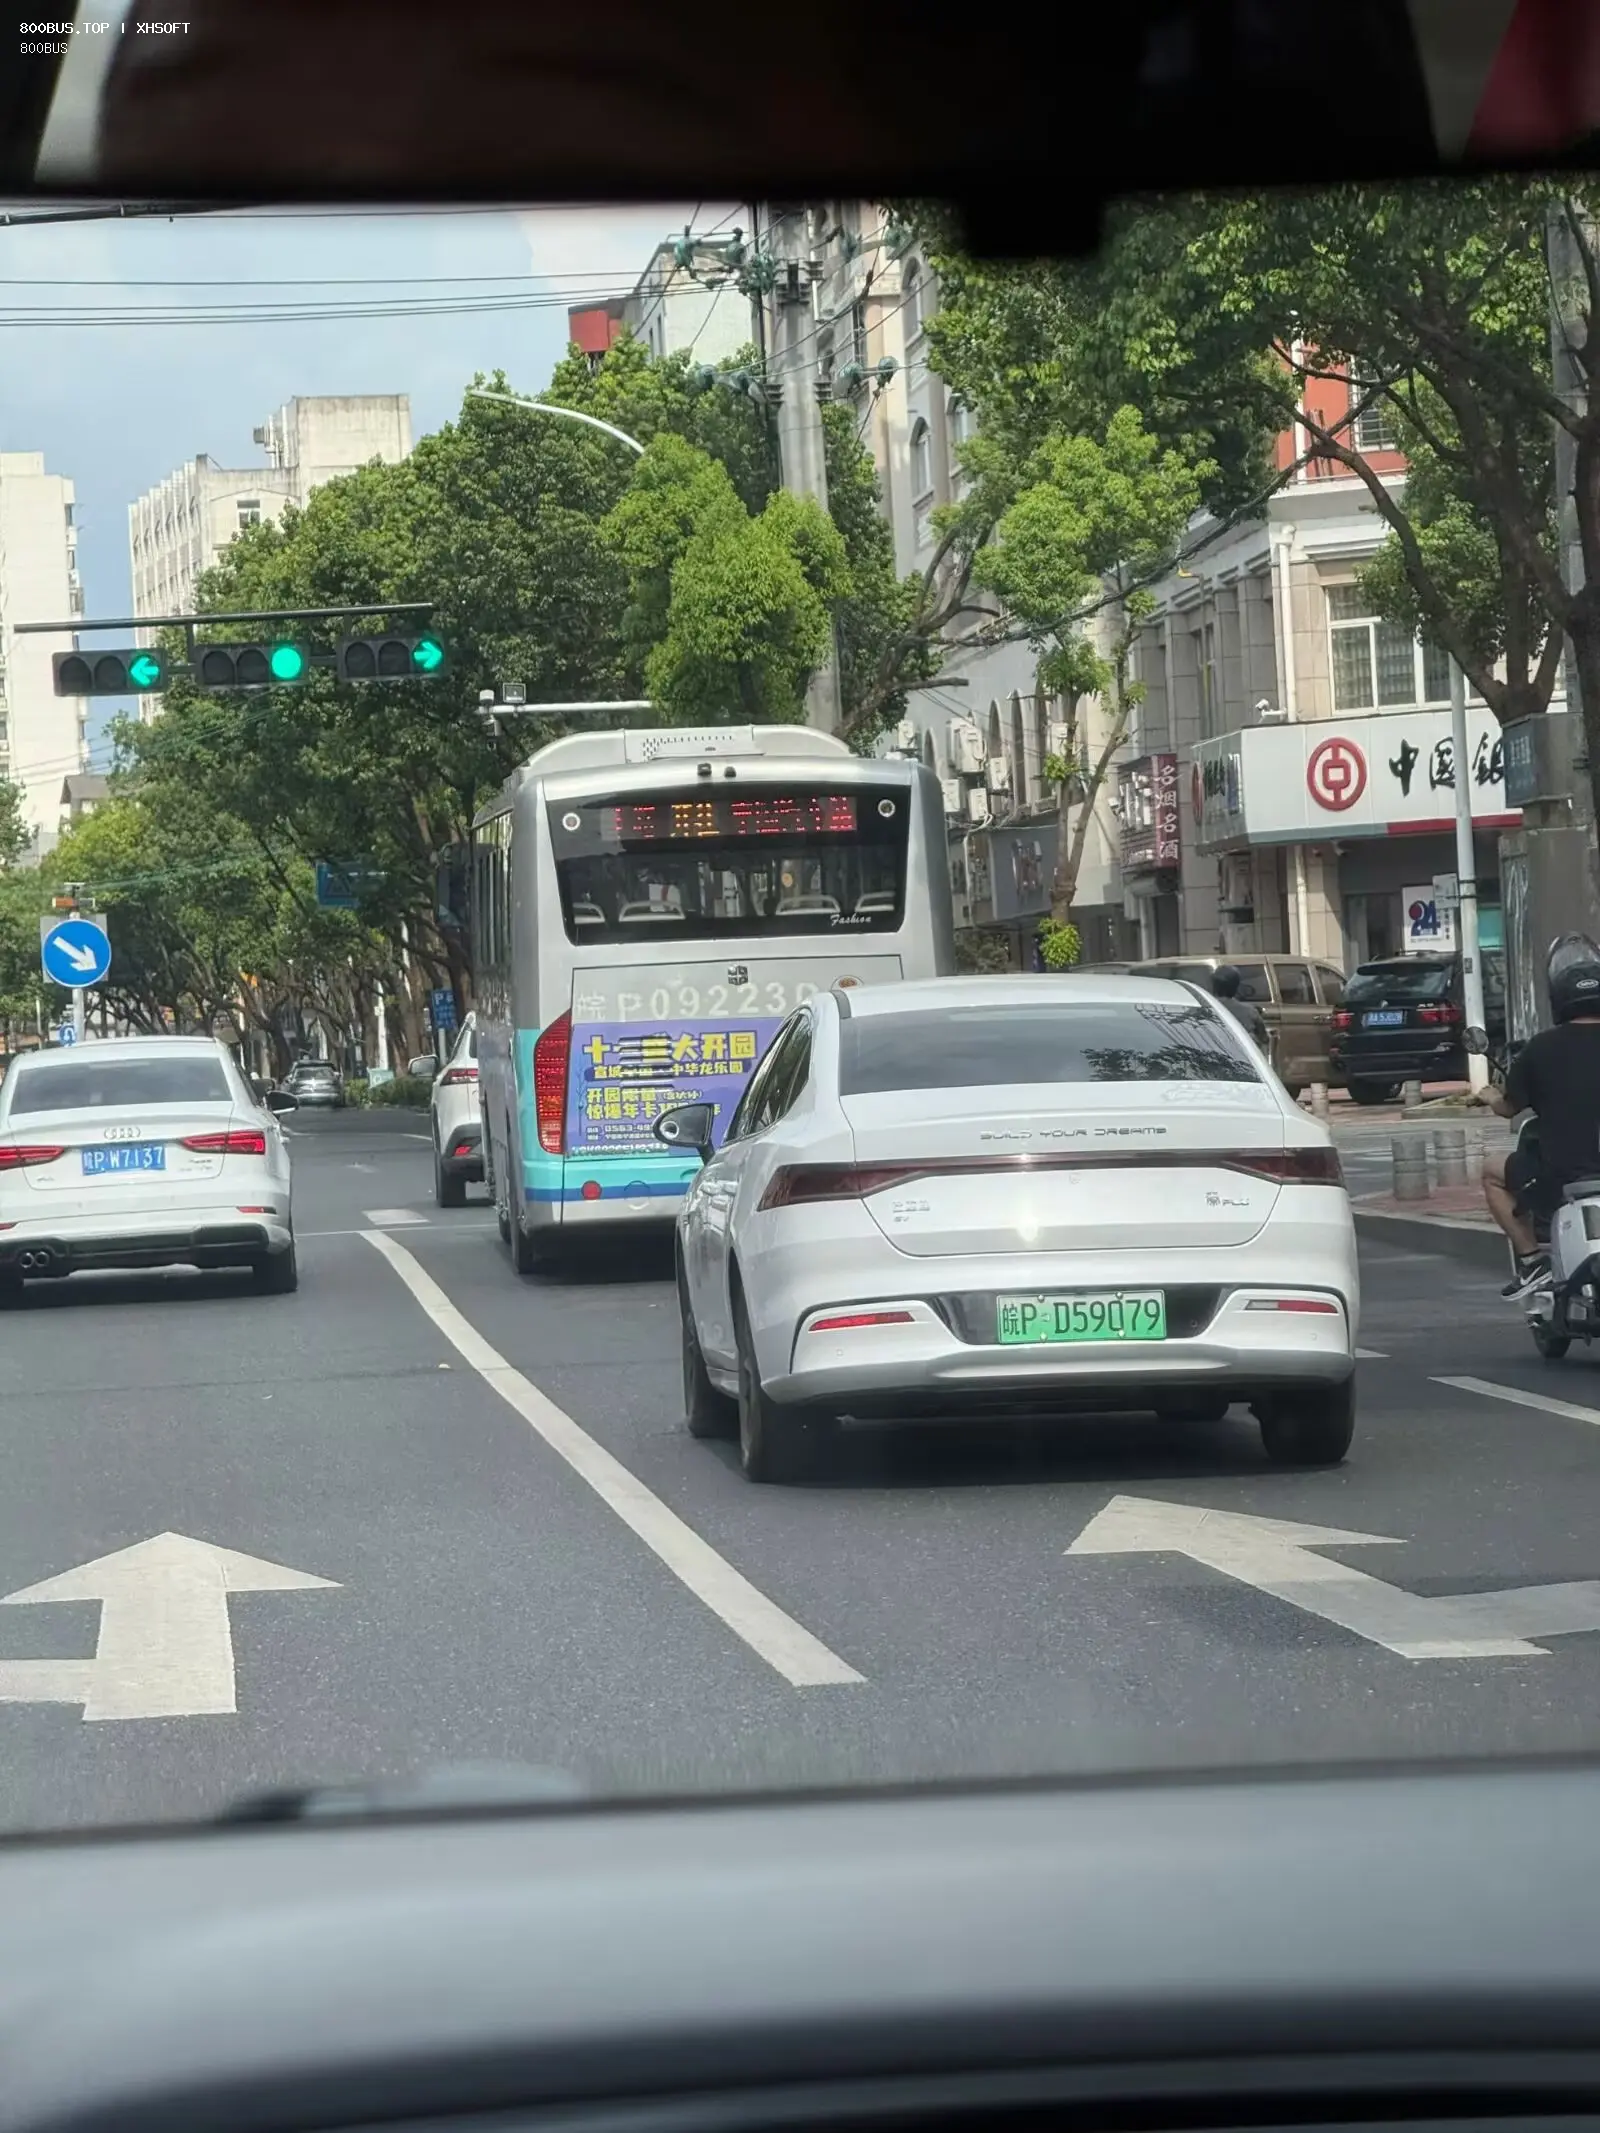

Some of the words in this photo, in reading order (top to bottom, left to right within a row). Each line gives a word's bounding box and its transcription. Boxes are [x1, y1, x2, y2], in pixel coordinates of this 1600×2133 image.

[1152, 764, 1179, 860] 名烟名酒
[830, 914, 872, 926] Fashion
[980, 1130, 1032, 1140] BUILD
[1040, 1129, 1087, 1138] YOUR
[1094, 1127, 1167, 1137] DREAMS
